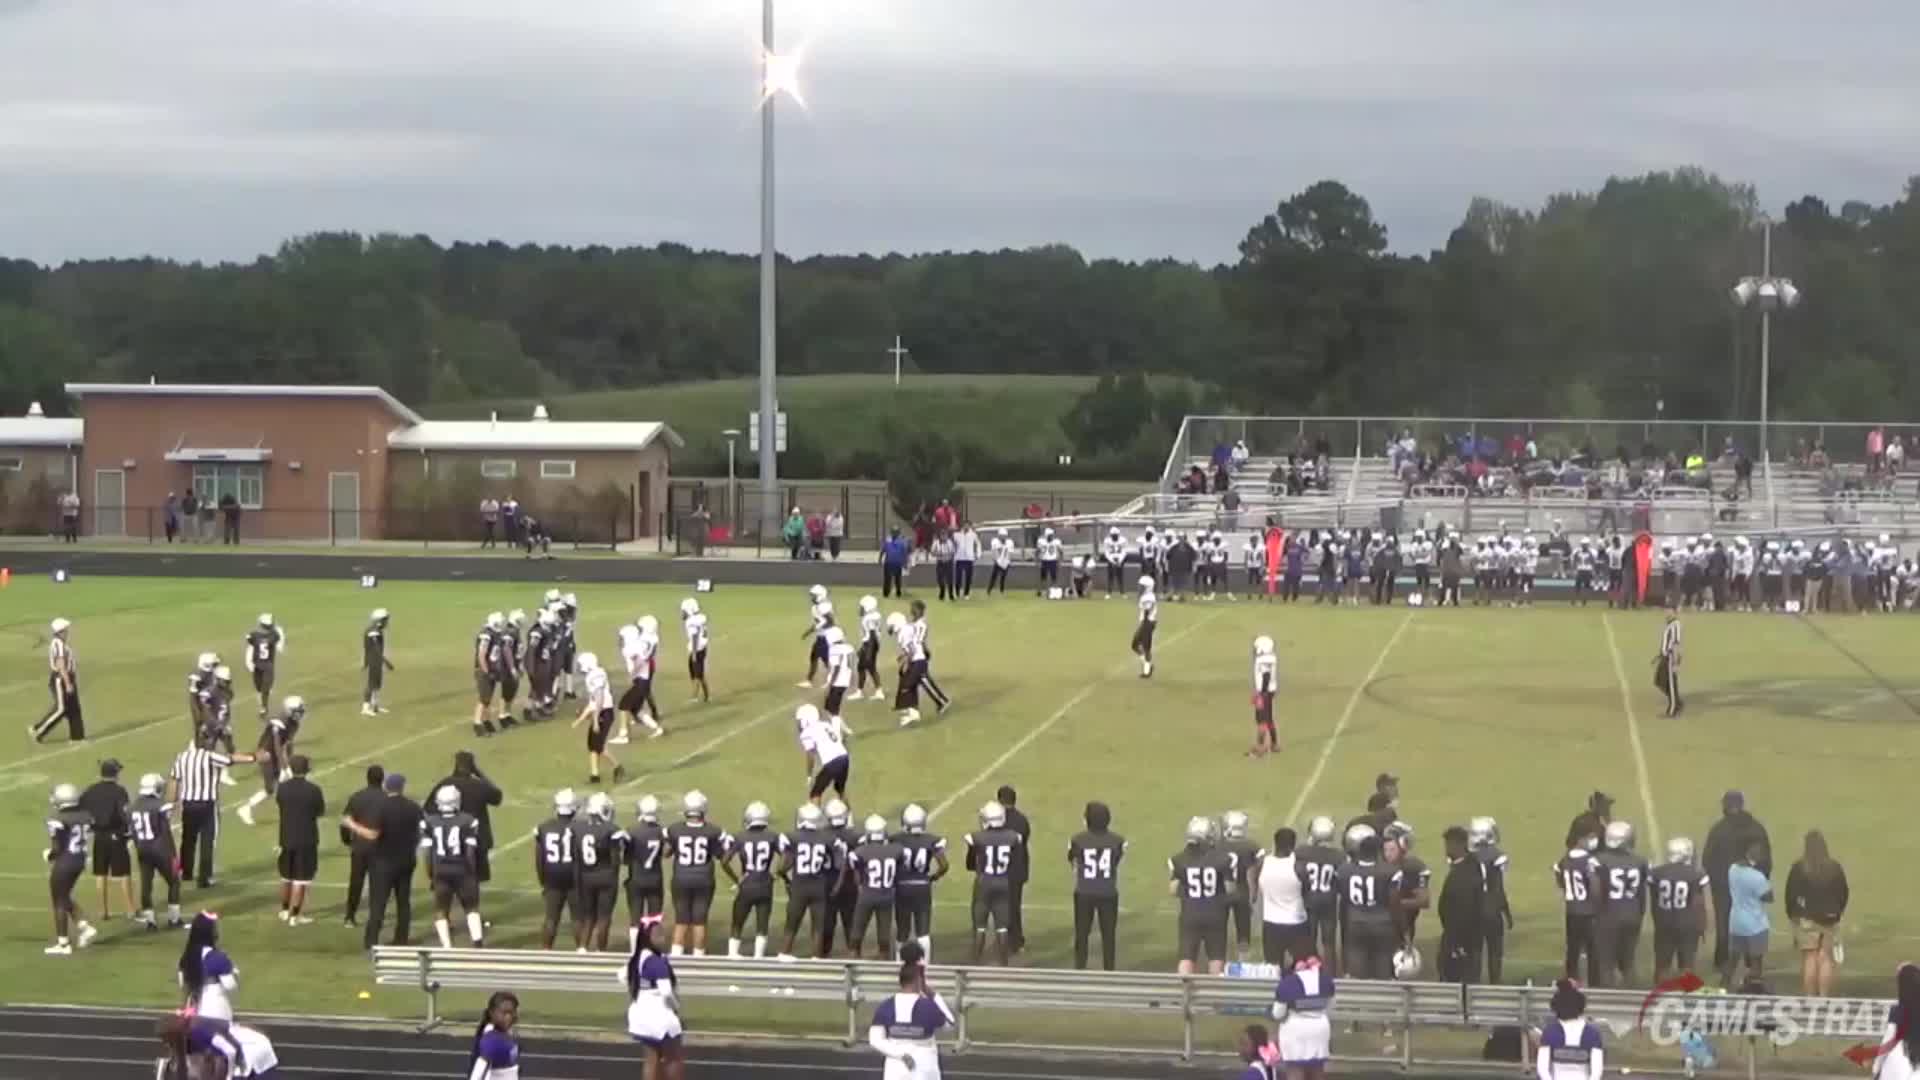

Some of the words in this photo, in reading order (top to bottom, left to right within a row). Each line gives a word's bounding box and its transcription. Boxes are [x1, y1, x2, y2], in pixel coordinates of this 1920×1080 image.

[258, 642, 269, 659] 5
[131, 811, 154, 840] 21
[433, 825, 461, 856] 14
[545, 827, 572, 863] 51
[581, 833, 597, 865] 6
[643, 839, 660, 869] 7
[677, 836, 708, 865] 56
[744, 841, 770, 871] 12
[797, 843, 826, 874] 26
[984, 845, 1011, 875] 15
[868, 858, 896, 888] 20
[1083, 848, 1111, 879] 54
[1187, 867, 1217, 898] 59
[1349, 875, 1376, 907] 61
[1563, 869, 1587, 901] 16
[1658, 880, 1689, 910] 28
